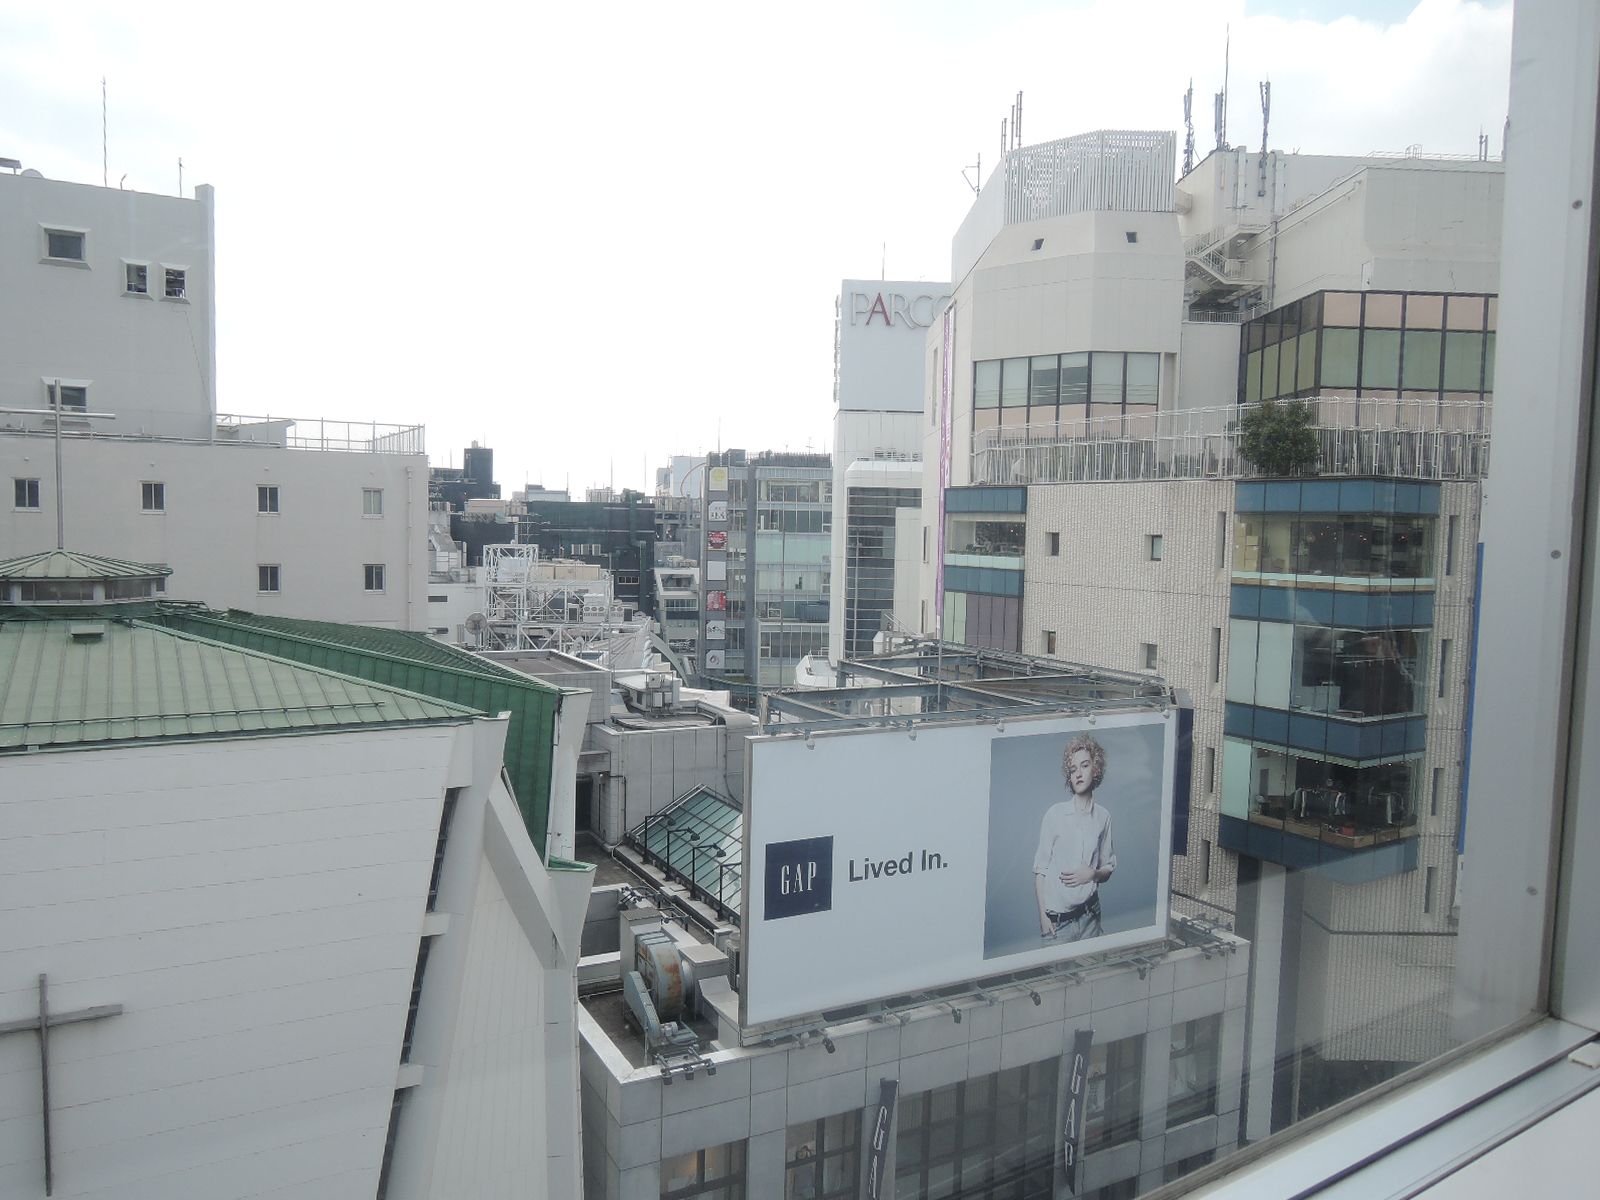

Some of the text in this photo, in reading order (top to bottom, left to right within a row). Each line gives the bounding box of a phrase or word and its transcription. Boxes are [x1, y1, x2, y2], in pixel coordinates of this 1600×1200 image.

[780, 861, 817, 896] GAP
[849, 849, 949, 883] Lived In.
[1063, 1053, 1084, 1173] GAP
